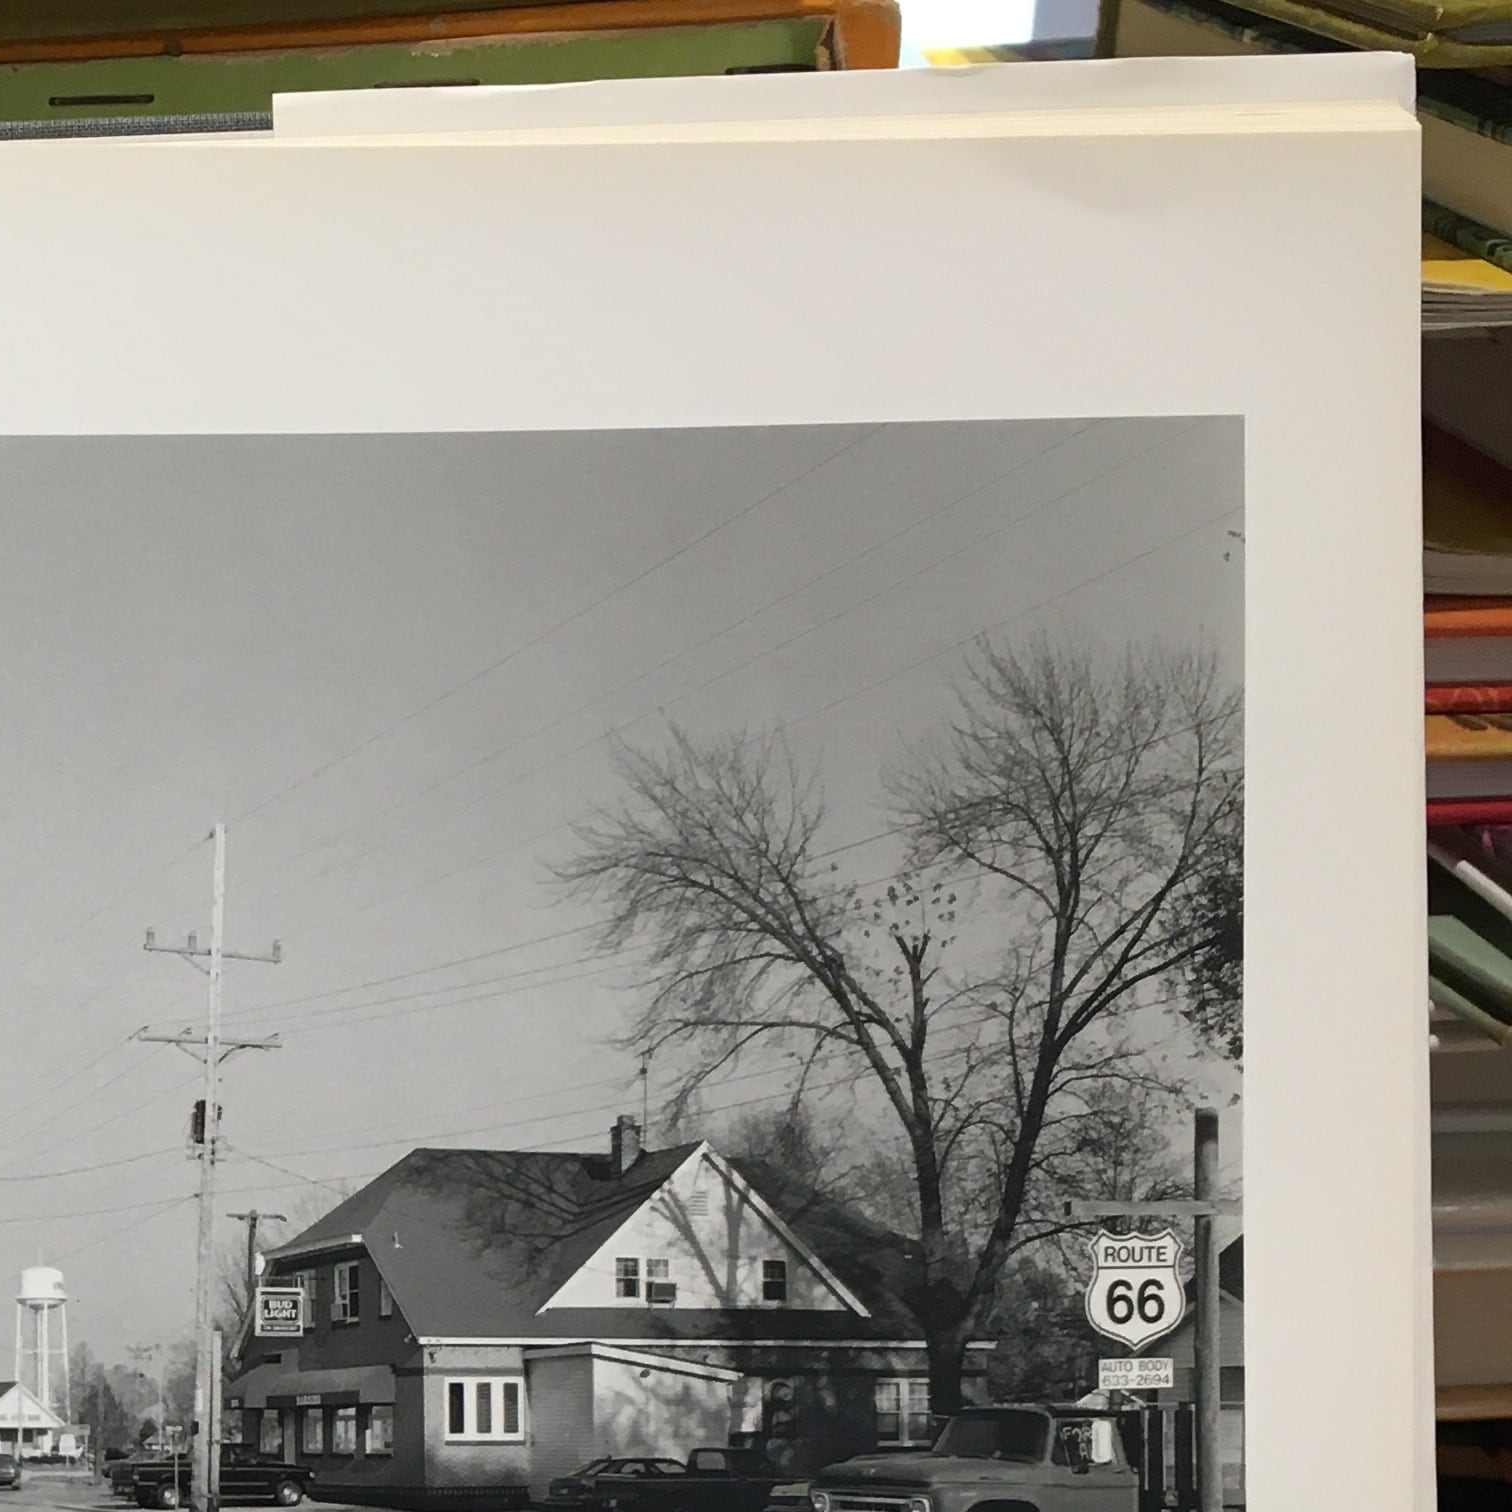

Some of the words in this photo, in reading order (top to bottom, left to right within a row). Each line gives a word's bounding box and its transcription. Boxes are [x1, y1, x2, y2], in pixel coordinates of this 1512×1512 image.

[1103, 1245, 1168, 1263] ROUTE
[268, 1299, 293, 1309] BUD
[1106, 1278, 1166, 1325] 66
[264, 1309, 297, 1318] LIGHT
[1101, 1360, 1133, 1373] AUTO
[1138, 1360, 1169, 1372] BODY
